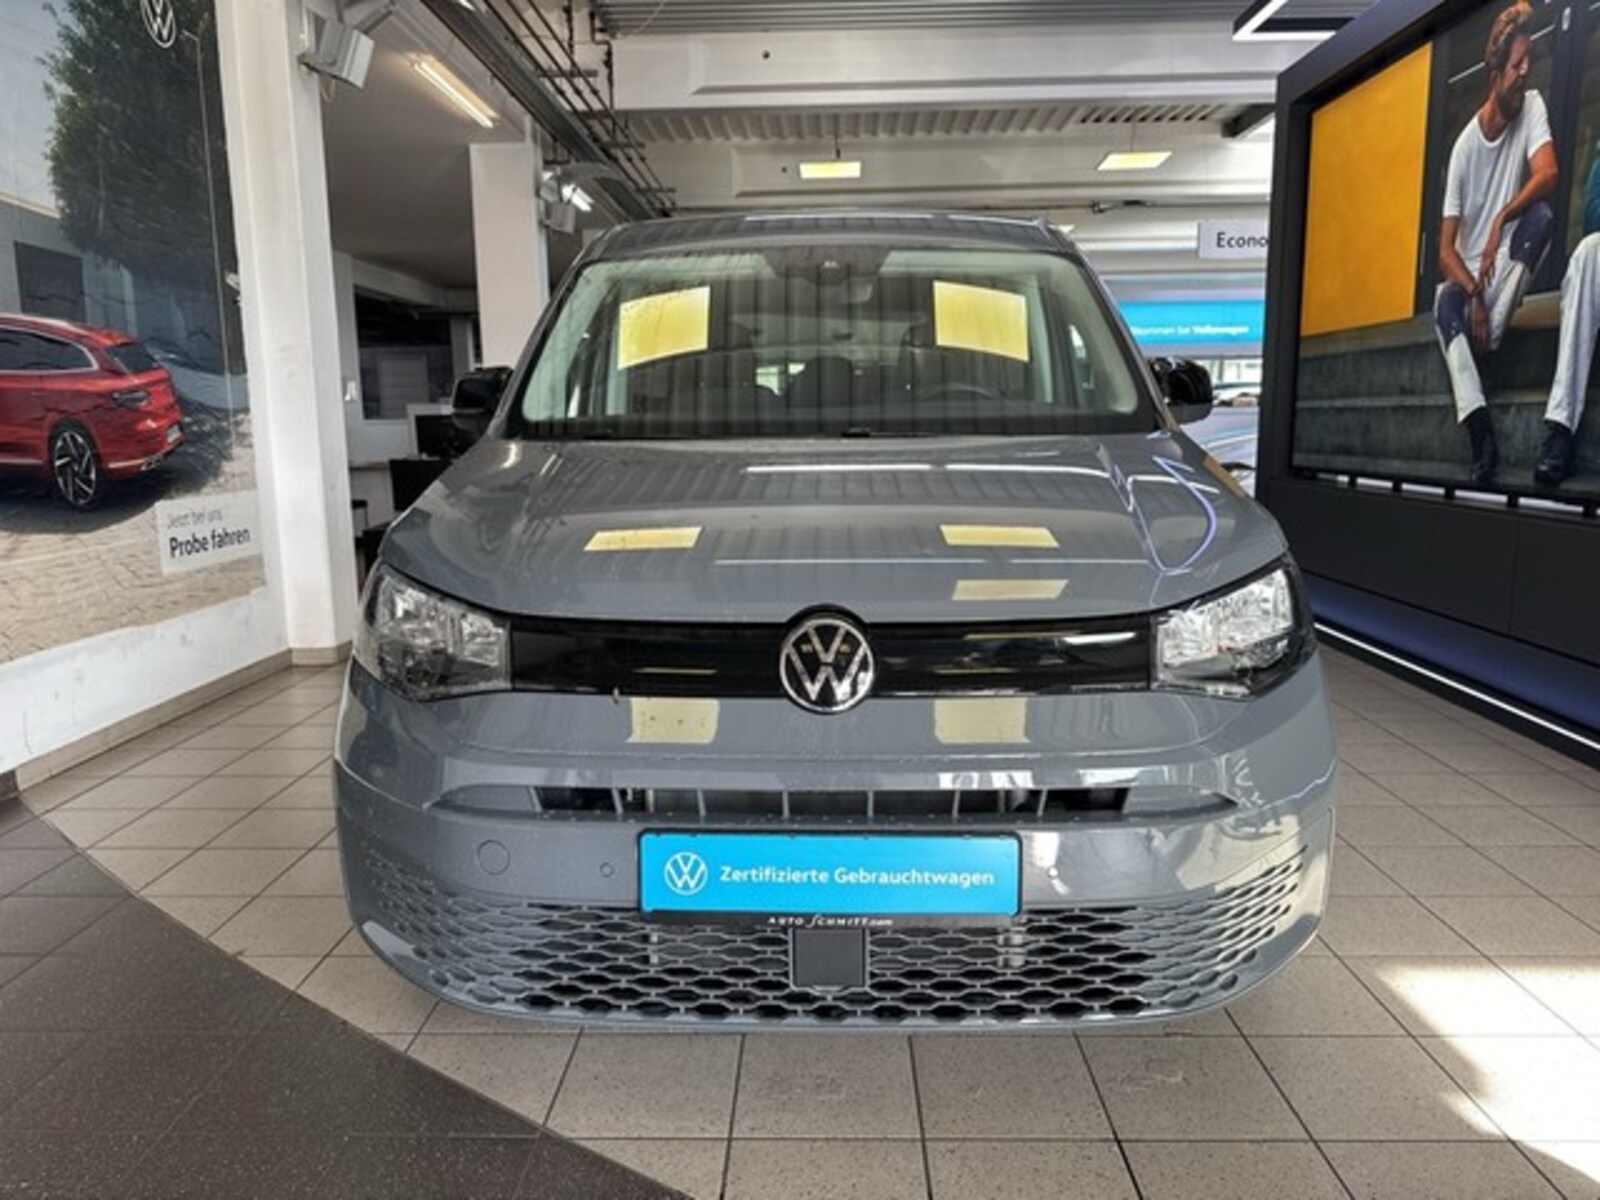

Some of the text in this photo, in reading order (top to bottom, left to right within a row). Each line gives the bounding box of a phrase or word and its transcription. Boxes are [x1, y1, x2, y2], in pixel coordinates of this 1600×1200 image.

[169, 527, 251, 558] Probe fahren
[719, 865, 829, 883] Zertifizierte
[834, 867, 995, 889] Gebrauchtwagen
[768, 916, 803, 926] AUTO
